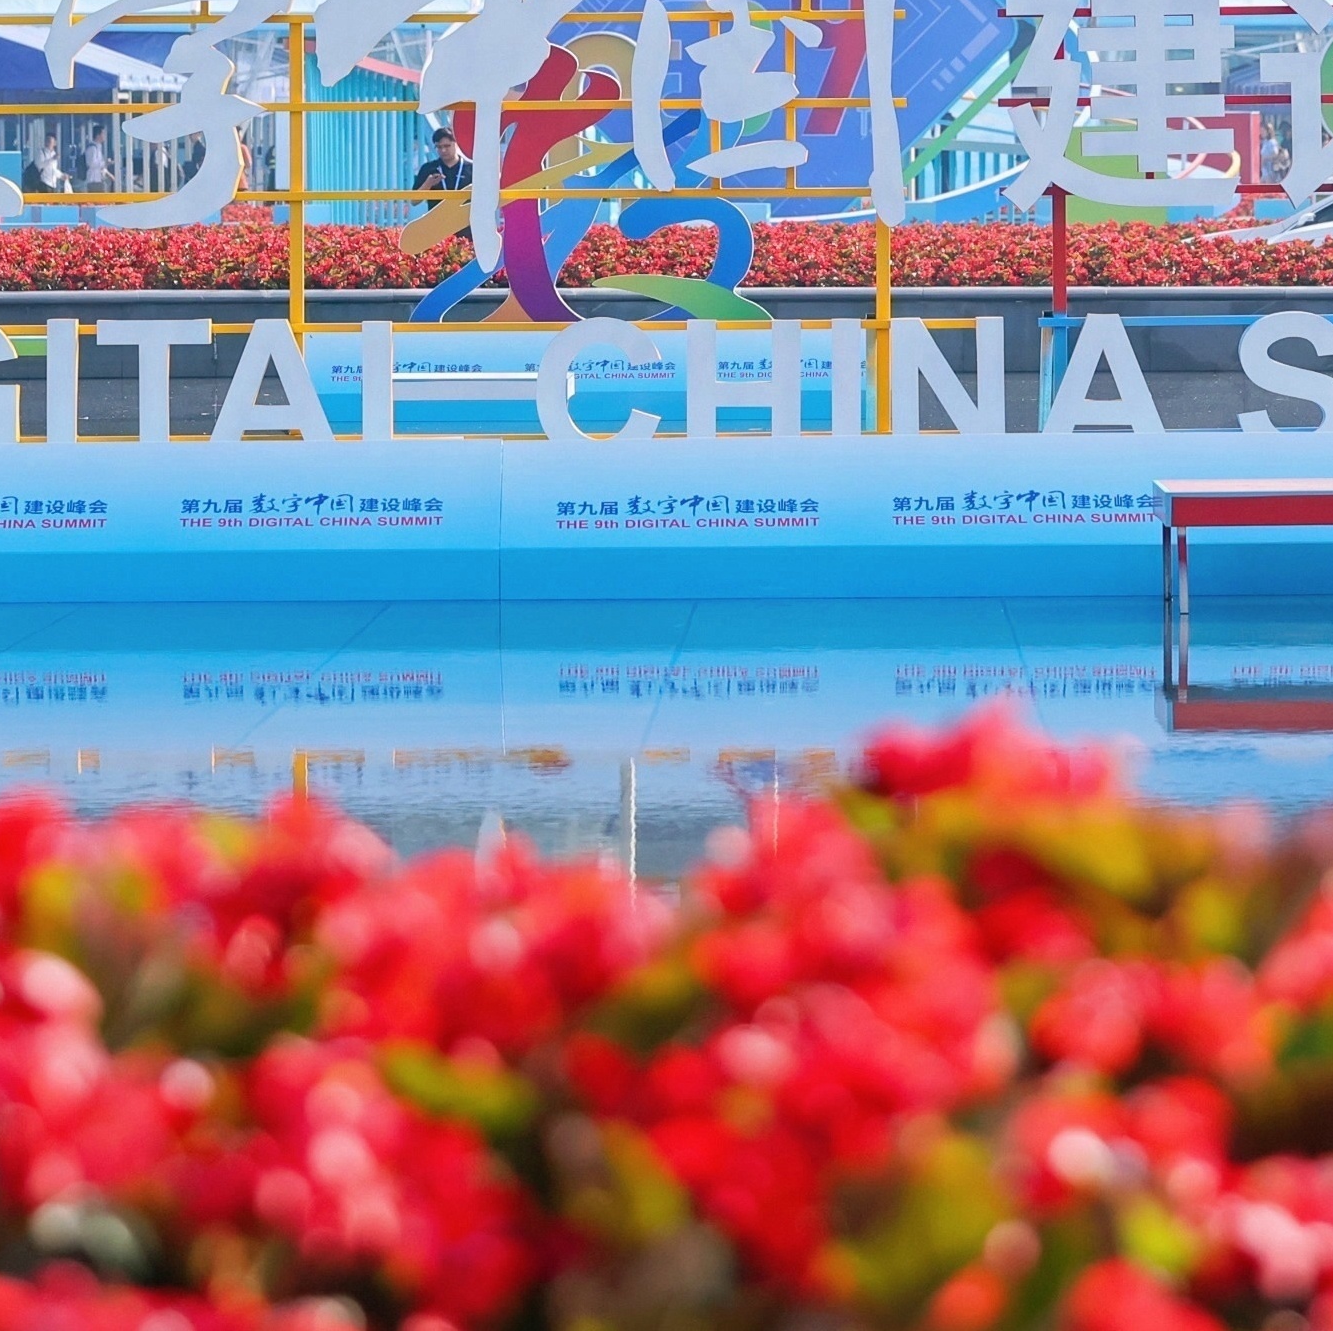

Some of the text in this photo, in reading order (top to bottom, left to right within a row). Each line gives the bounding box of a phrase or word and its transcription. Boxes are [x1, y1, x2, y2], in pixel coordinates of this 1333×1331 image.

[536, 313, 1166, 441] CHINA
[181, 493, 444, 516] 第九届数字中国建设峰会
[556, 494, 820, 517] 第九届数字中国建设峰会
[892, 489, 1154, 511] 第九届数字中国建设峰会
[40, 518, 108, 529] SUMMIT
[179, 515, 444, 528] THE 9th DIGITAL CHINA SUMMIT
[555, 516, 821, 530] THE 9th DIGITAL CHINA SUMMIT
[891, 512, 1156, 526] THE 9th DIGITAL CHINA SUMMIT
